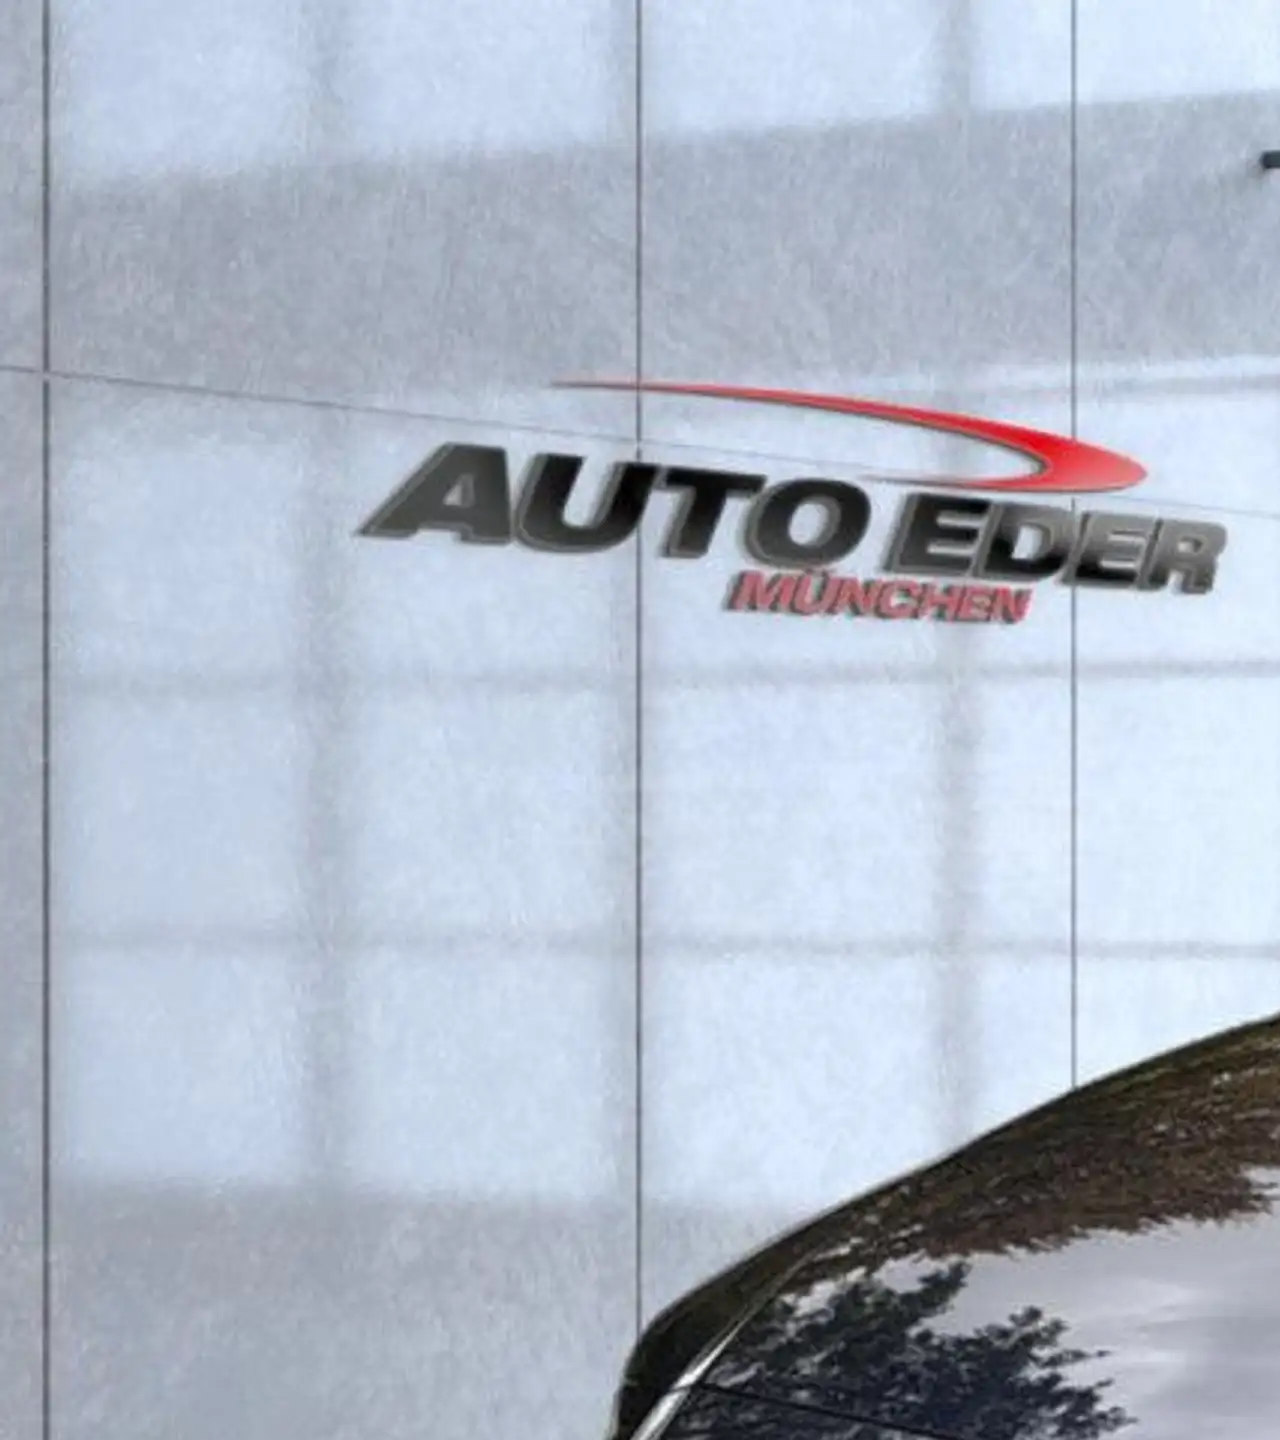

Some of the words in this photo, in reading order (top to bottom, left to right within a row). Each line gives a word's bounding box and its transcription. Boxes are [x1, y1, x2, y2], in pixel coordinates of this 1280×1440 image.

[357, 441, 871, 566] AUTO
[885, 492, 1229, 595] EDER
[725, 568, 1033, 624] MÜNCHEN
